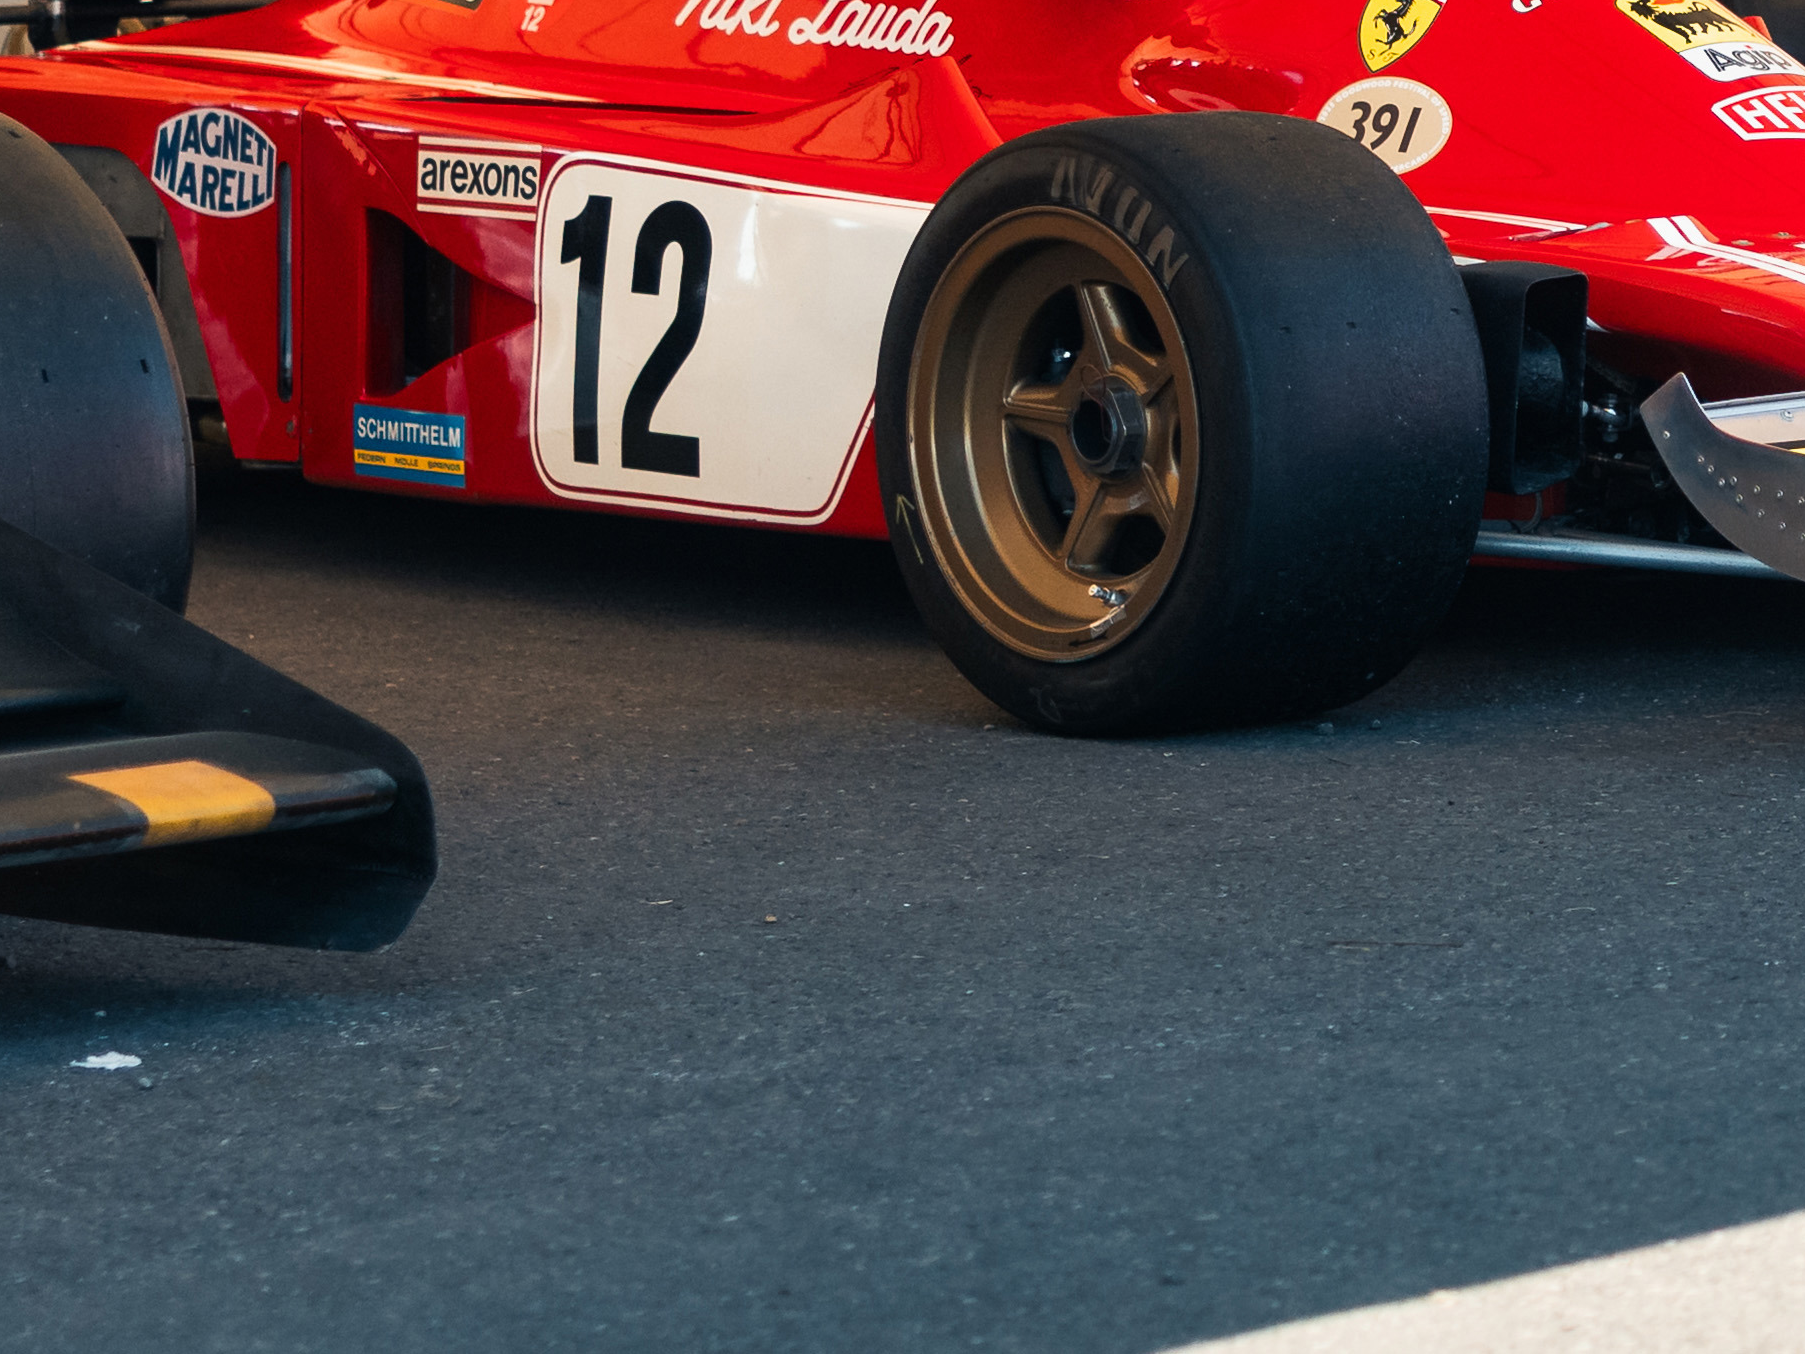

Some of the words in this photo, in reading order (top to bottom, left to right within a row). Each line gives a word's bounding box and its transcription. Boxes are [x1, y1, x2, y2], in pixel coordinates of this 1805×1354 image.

[521, 6, 545, 32] 12
[1705, 44, 1794, 73] Agip
[1335, 79, 1391, 104] GOODWOOD
[1393, 79, 1432, 100] FESTIVAL
[1351, 101, 1422, 153] 391
[155, 112, 274, 182] MAGNETI
[420, 157, 538, 200] arexons
[560, 194, 712, 478] 12
[357, 417, 461, 448] SCHMITTHELM
[357, 452, 386, 464] FEDERN
[428, 461, 461, 472] SPRINGS
